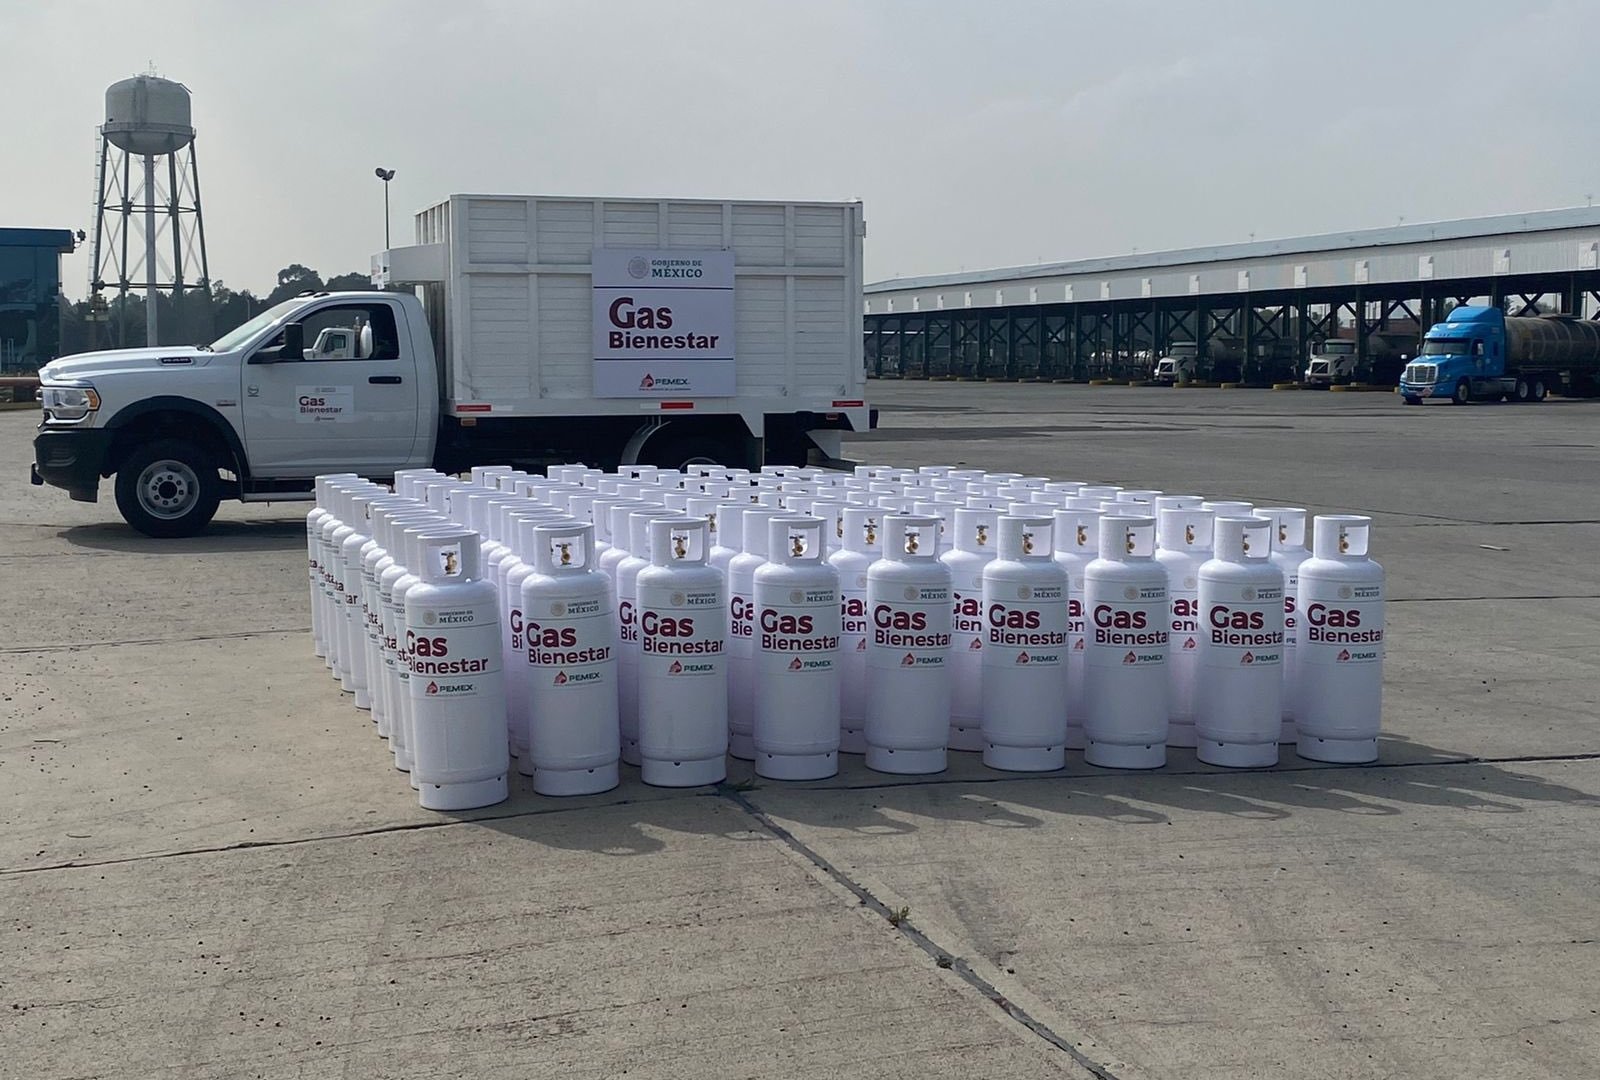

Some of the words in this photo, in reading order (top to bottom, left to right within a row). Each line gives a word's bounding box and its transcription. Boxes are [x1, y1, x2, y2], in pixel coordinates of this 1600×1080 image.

[651, 259, 691, 267] GOBIERNO
[692, 259, 703, 267] DE
[651, 266, 703, 278] MÉXICO
[609, 297, 673, 330] Gas
[609, 331, 720, 349] Bienestar
[298, 395, 326, 407] Gas
[300, 406, 343, 414] Bienestar
[567, 604, 600, 614] MÉXICO
[731, 596, 754, 621] Ga
[989, 604, 1041, 629] Gas
[1094, 604, 1147, 629] Gas
[1307, 603, 1361, 628] Gas
[439, 615, 474, 624] MÉXICO
[642, 611, 694, 637] Gas
[761, 609, 813, 634] Gas
[874, 605, 927, 631] Gas
[1210, 605, 1264, 630] Gas
[526, 622, 577, 648] Gas
[762, 634, 840, 651] Bienestar
[875, 629, 952, 646] Bienestar
[990, 628, 1068, 645] Bienestar
[1211, 629, 1283, 646] Bienesta
[643, 636, 724, 654] Bienestar
[528, 646, 611, 665] Bienestar
[916, 656, 944, 664] PEMEX
[1030, 655, 1059, 663] PEMEX
[569, 671, 600, 682] PEMEX
[683, 664, 714, 672] PEMEX
[439, 684, 474, 692] PEMEX
